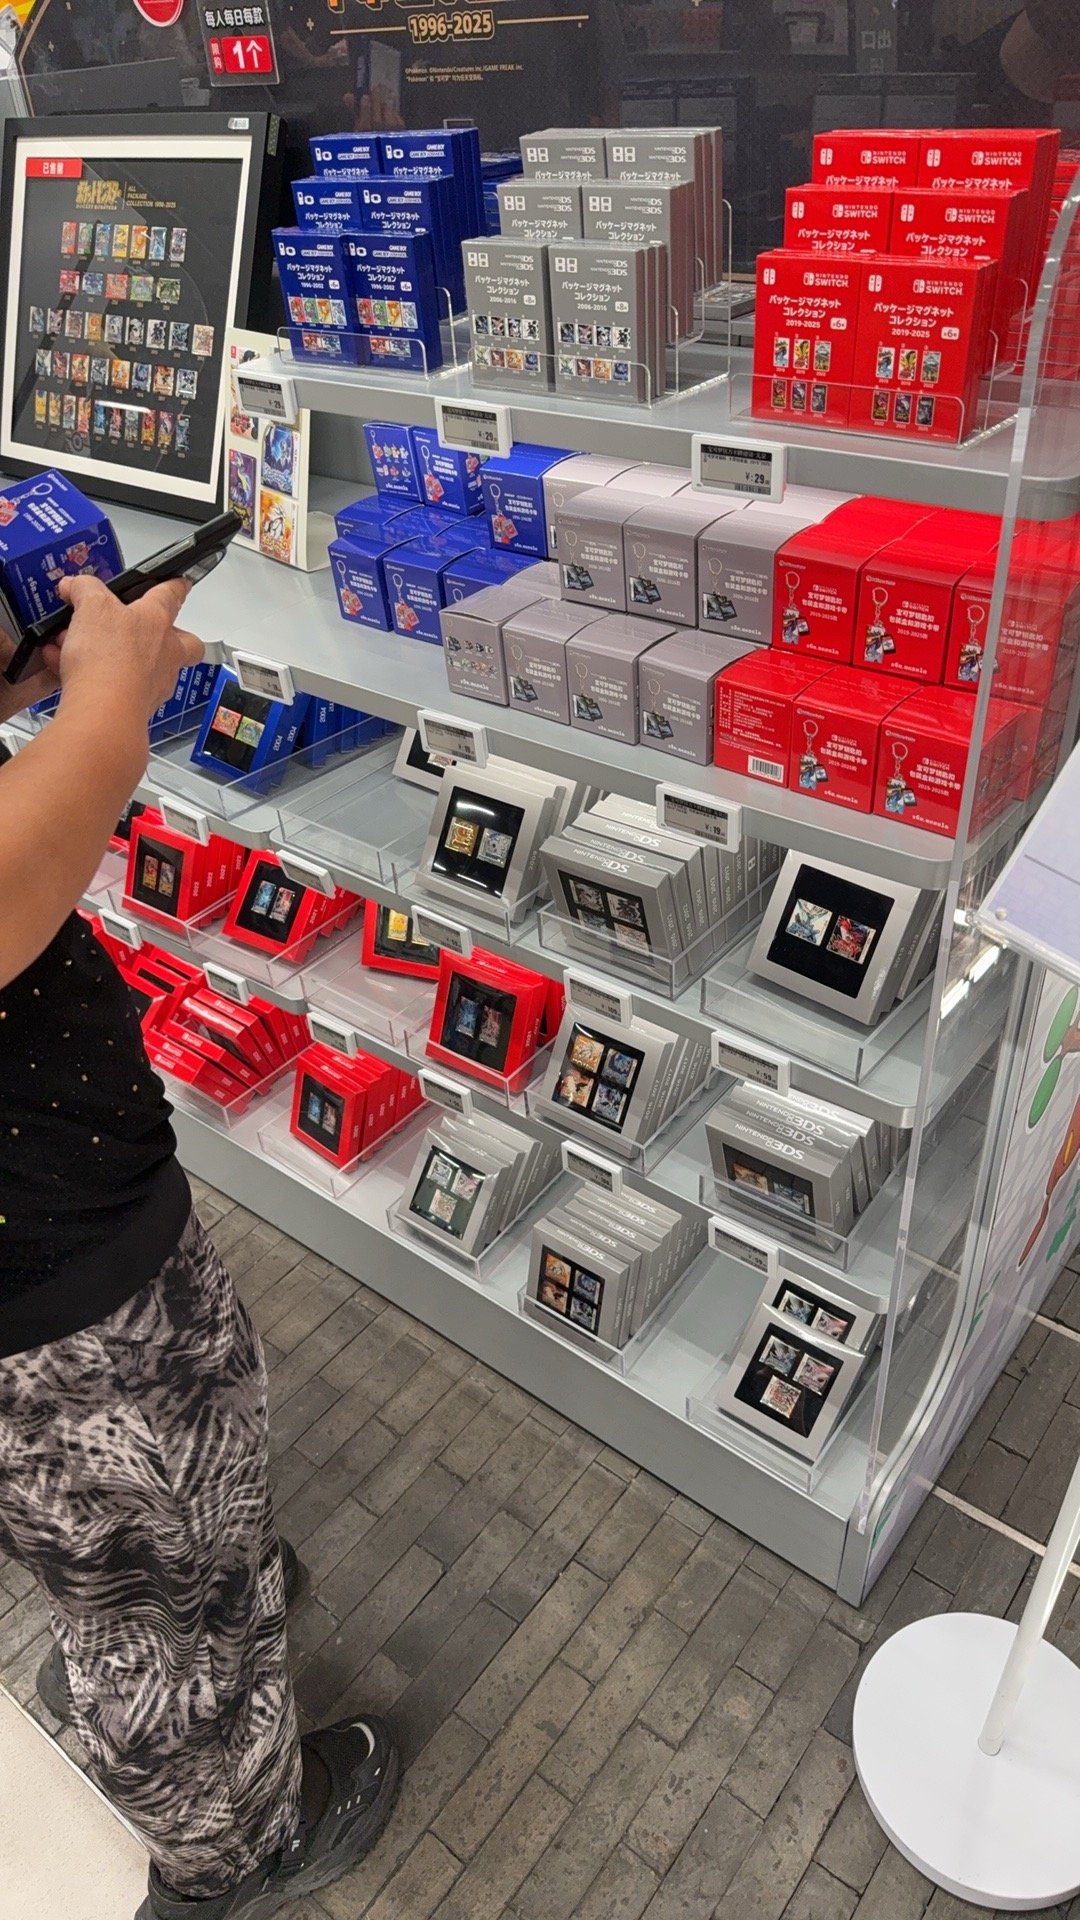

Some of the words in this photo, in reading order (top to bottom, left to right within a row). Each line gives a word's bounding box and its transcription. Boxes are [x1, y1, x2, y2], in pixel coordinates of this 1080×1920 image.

[205, 7, 264, 28] 每人每日每款
[409, 14, 494, 38] 1996-2025
[232, 40, 263, 69] 1个
[872, 156, 907, 165] SWITCH
[984, 156, 1023, 166] SWITCH
[535, 171, 593, 180] パッケージマグネット
[620, 171, 681, 181] パッケージマグネット
[826, 176, 899, 187] パッケージマグネット
[932, 177, 1013, 190] パッケージマグネット
[305, 212, 350, 221] パッケージマグネット
[371, 212, 420, 221] パッケージマグネット
[843, 209, 878, 218] SWITCH
[958, 214, 996, 224] SWITCH
[382, 221, 412, 230] コレクション
[512, 219, 569, 230] パッケージマグネット
[596, 220, 657, 232] パッケージマグネット
[524, 229, 558, 239] コレクション
[608, 231, 645, 241] コレクション
[798, 229, 871, 241] パッケージマグネット
[906, 233, 986, 246] パッケージマグネット
[812, 241, 856, 252] コレクション
[920, 245, 969, 257] コレクション
[287, 263, 333, 273] パッケージマグネット
[357, 265, 406, 274] パッケージマグネット
[298, 273, 326, 281] コレクション
[368, 274, 396, 283] コレクション
[475, 275, 530, 287] パッケージマグネット
[562, 281, 623, 294] パッケージマグネット
[815, 278, 849, 288] SWITCH
[926, 280, 963, 288] NINTENDO
[487, 285, 520, 296] コレクション
[925, 286, 963, 296] SWITCH
[489, 296, 517, 305] 2006-2016
[574, 292, 611, 303] コレクション
[769, 295, 842, 309] パッケージマグネット
[577, 303, 608, 312] 2006-2016
[783, 307, 826, 318] コレクション
[874, 303, 954, 318] パッケージマグネット
[785, 319, 821, 329] 2019-2025
[889, 315, 937, 328] コレクション
[891, 328, 931, 338] 2019-2025
[605, 824, 638, 840] NINTENDO
[636, 835, 662, 848] DS
[590, 839, 623, 856] NINTENDO
[619, 850, 647, 864] DS
[573, 848, 609, 866] NINTENDO
[603, 859, 630, 874] DS
[757, 1100, 796, 1118] NINTENDO
[787, 1112, 826, 1137] 3DS
[746, 1110, 784, 1128] NINTENDO
[776, 1121, 816, 1147] 3DS
[735, 1124, 772, 1141] NINTENDO
[766, 1134, 805, 1161] 3DS
